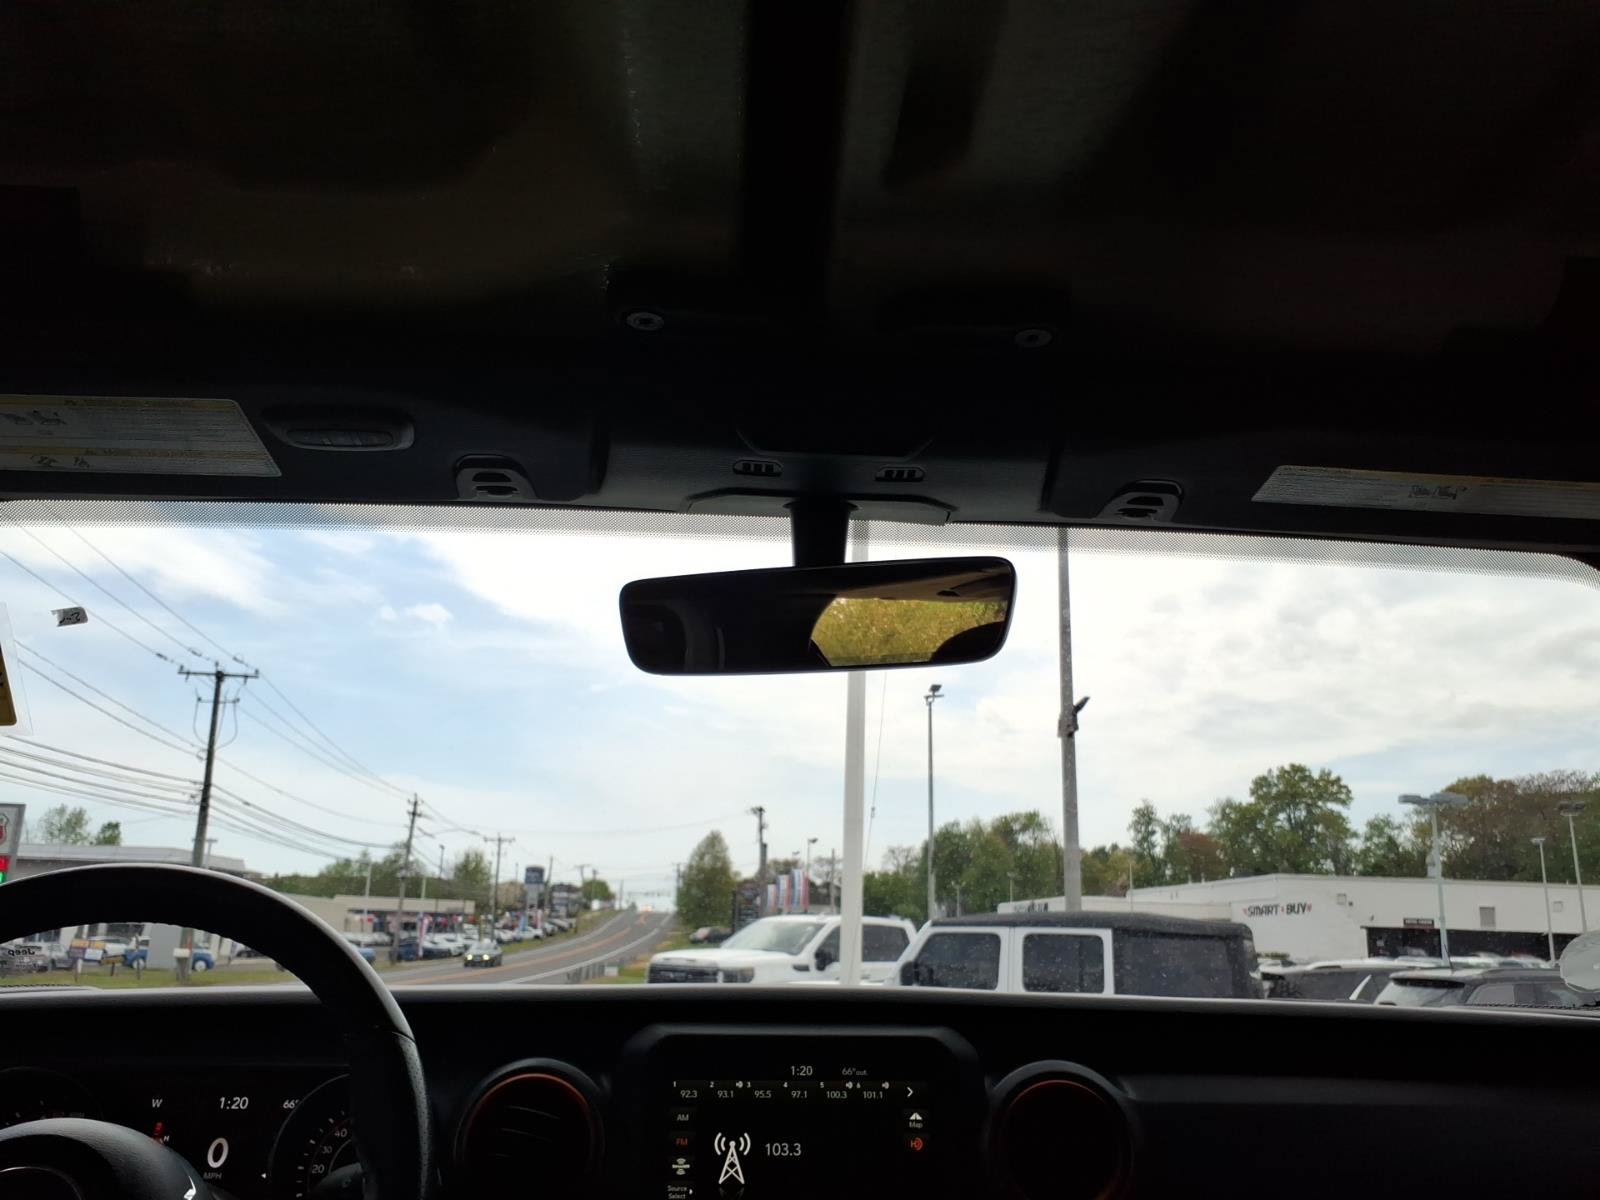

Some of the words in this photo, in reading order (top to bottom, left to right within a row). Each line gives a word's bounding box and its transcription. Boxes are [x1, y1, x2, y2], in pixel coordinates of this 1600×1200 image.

[1247, 903, 1279, 917] SMART
[1286, 902, 1307, 915] BUY
[790, 1065, 813, 1077] 1:20
[680, 1090, 698, 1098] 92.3
[717, 1090, 734, 1098] 93.1
[754, 1090, 772, 1099] 95.5
[791, 1090, 808, 1099] 97.1
[826, 1090, 848, 1099] 100.3
[863, 1091, 884, 1099] 101.1
[151, 1098, 163, 1108] W
[219, 1096, 249, 1110] 1:20
[676, 1113, 689, 1121] AM
[334, 1128, 348, 1138] 40
[207, 1137, 229, 1169] 0
[764, 1142, 802, 1157] 103.3
[311, 1164, 325, 1174] 20
[203, 1172, 222, 1180] MPH
